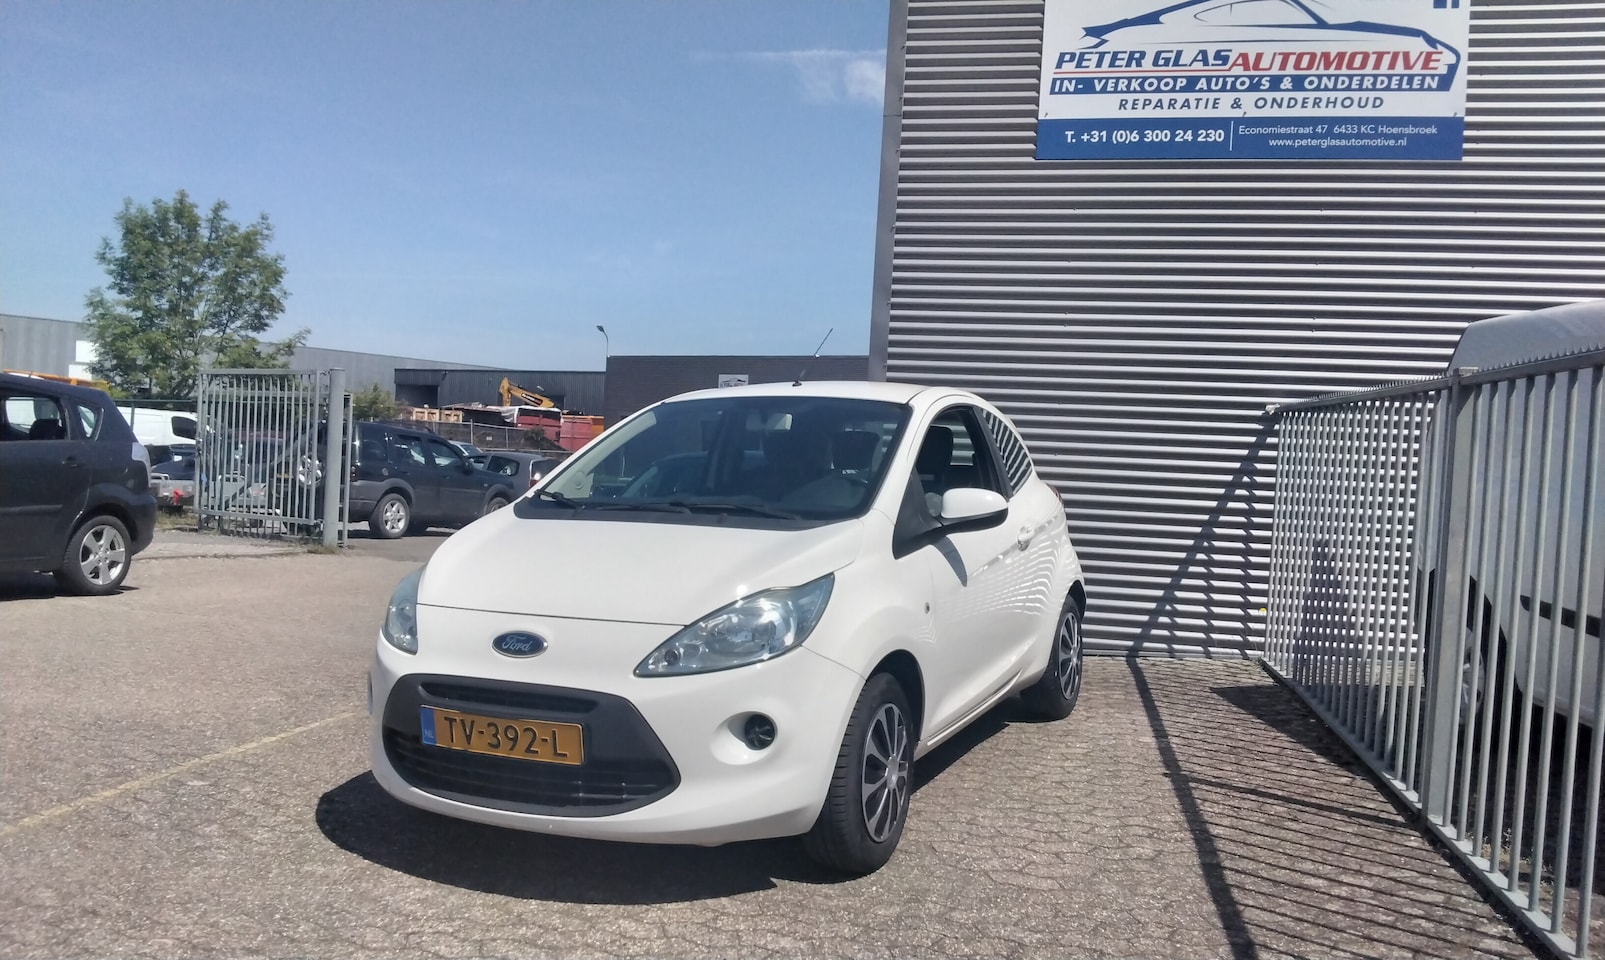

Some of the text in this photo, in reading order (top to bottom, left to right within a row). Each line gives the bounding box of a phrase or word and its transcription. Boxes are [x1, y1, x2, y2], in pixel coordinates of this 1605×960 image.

[1054, 49, 1444, 72] PETER GLAS AUTOMOTIVE
[1053, 75, 1439, 93] IN- VERKOOP AUTO'S & ONDERDELEN
[1117, 96, 1385, 111] REPARATIE & ONDERHOUD
[1064, 129, 1225, 145] T. +31 (0)6 300 24 230
[1238, 124, 1438, 135] Economiestraat 47 6433 KC Hoensbroek
[1268, 136, 1407, 147] www.peterglasautomotive.nl
[502, 635, 533, 651] Ford
[444, 716, 568, 758] TV-392-L
